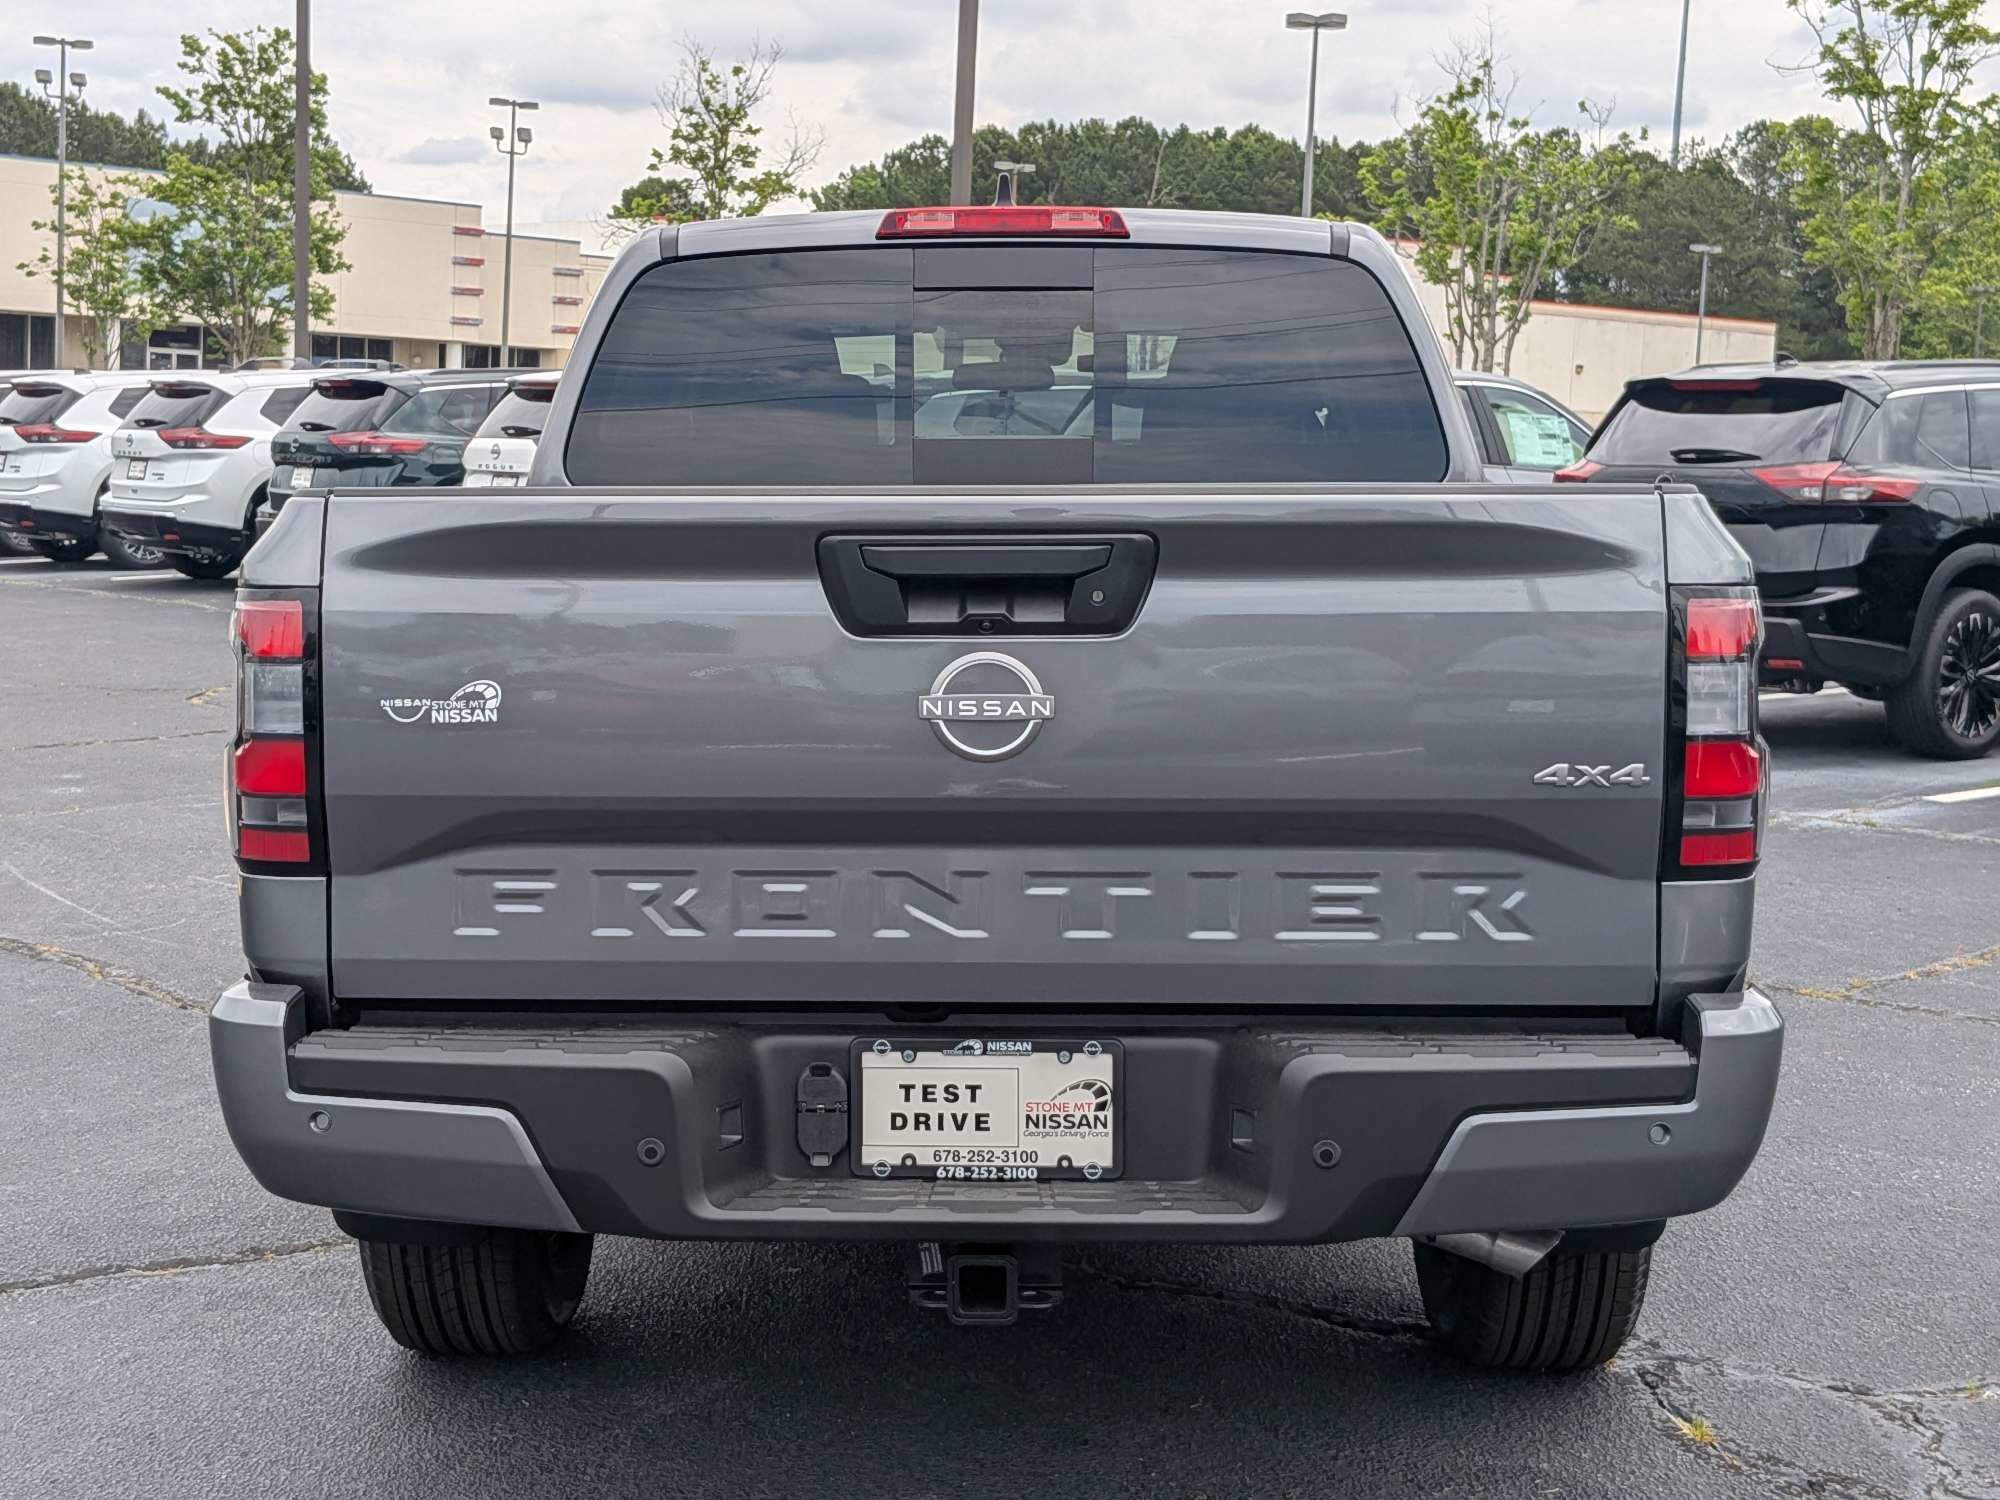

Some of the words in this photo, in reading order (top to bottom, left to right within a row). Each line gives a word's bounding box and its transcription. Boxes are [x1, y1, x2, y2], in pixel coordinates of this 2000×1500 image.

[380, 699, 431, 707] NISSAN
[432, 701, 466, 709] STONE
[469, 700, 485, 708] MT
[922, 700, 1051, 716] NISSAN
[431, 709, 498, 723] NISSAN
[453, 868, 1534, 942] FRONTIER
[987, 1041, 1032, 1051] NISSAN
[899, 1084, 982, 1103] TEST
[1025, 1102, 1070, 1112] STONE
[1073, 1102, 1093, 1112] MT
[890, 1113, 990, 1131] DRIVE
[1025, 1114, 1108, 1129] NISSAN
[1023, 1130, 1059, 1138] Georgia's
[1060, 1130, 1086, 1138] Driving
[933, 1150, 1039, 1163] 678-252-3100
[937, 1168, 1038, 1179] 678-252-3100
